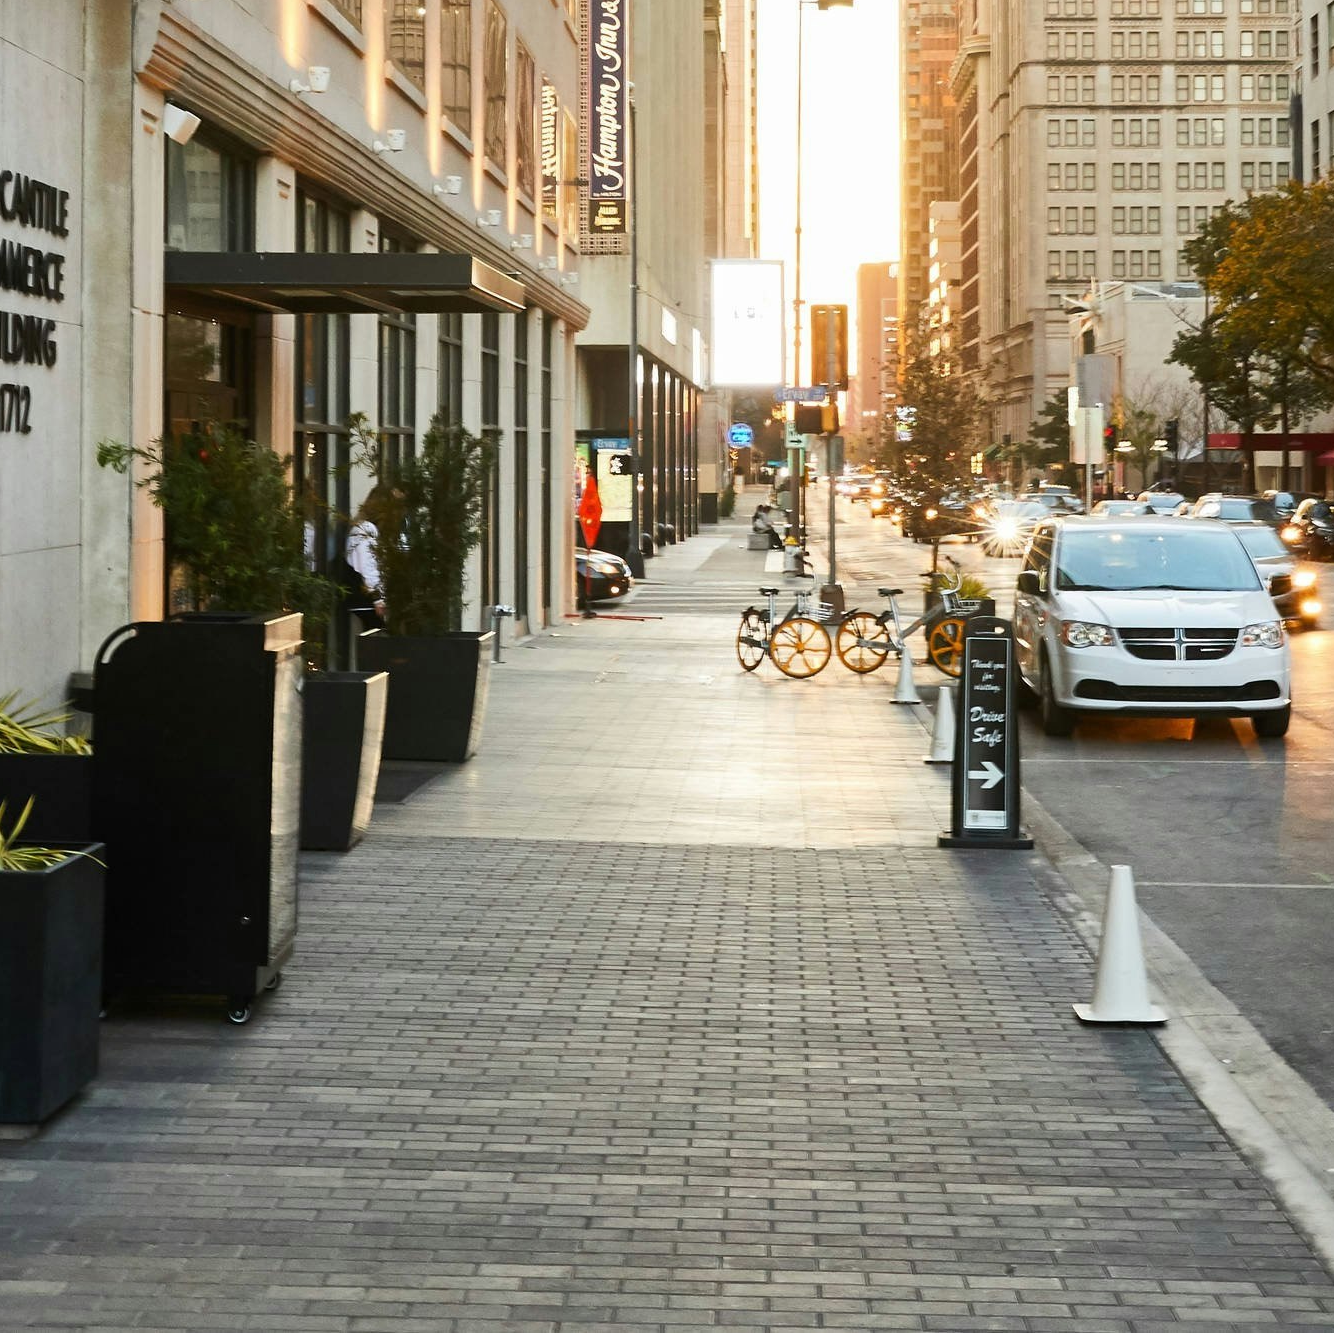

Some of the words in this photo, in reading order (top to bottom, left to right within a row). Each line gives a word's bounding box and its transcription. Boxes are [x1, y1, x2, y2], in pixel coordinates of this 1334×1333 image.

[592, 74, 624, 191] Hampton
[970, 706, 1005, 722] Drive
[972, 727, 1004, 747] Safe
